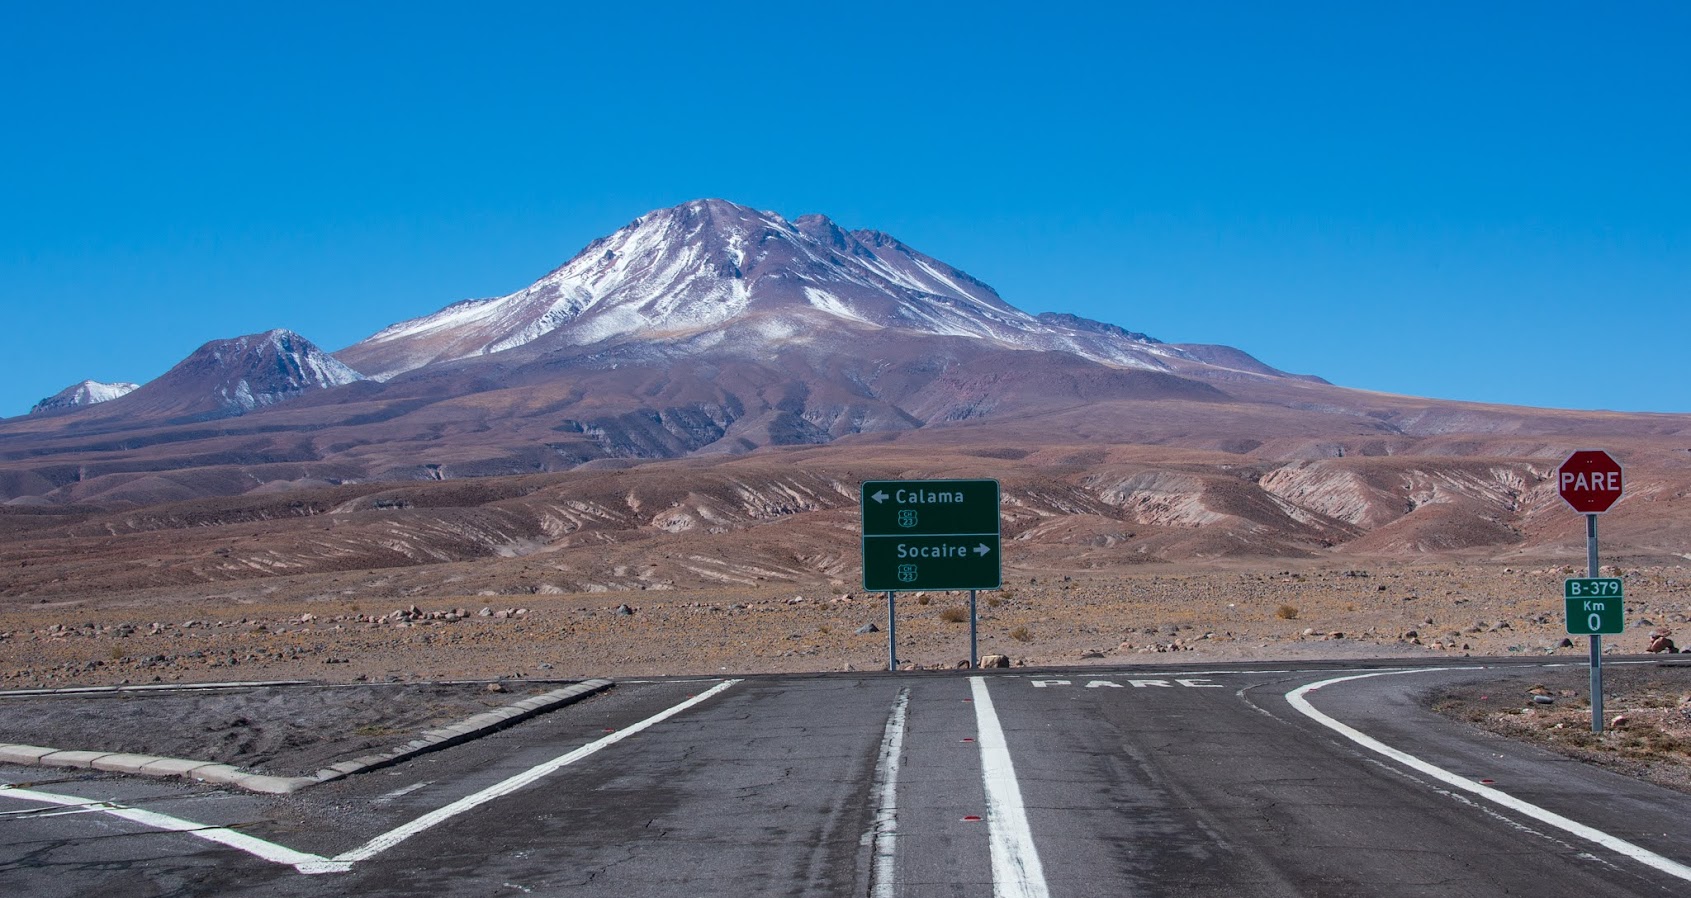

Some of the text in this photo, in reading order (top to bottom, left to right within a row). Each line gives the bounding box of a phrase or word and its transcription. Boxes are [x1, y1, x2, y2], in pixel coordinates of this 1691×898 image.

[1561, 471, 1620, 491] PARE
[895, 489, 964, 504] Calama
[903, 518, 913, 526] 23
[897, 543, 967, 558] Socaire
[1571, 581, 1619, 595] B-379
[1583, 600, 1605, 611] Km
[1587, 612, 1601, 631] 0
[1030, 678, 1224, 688] PARE
